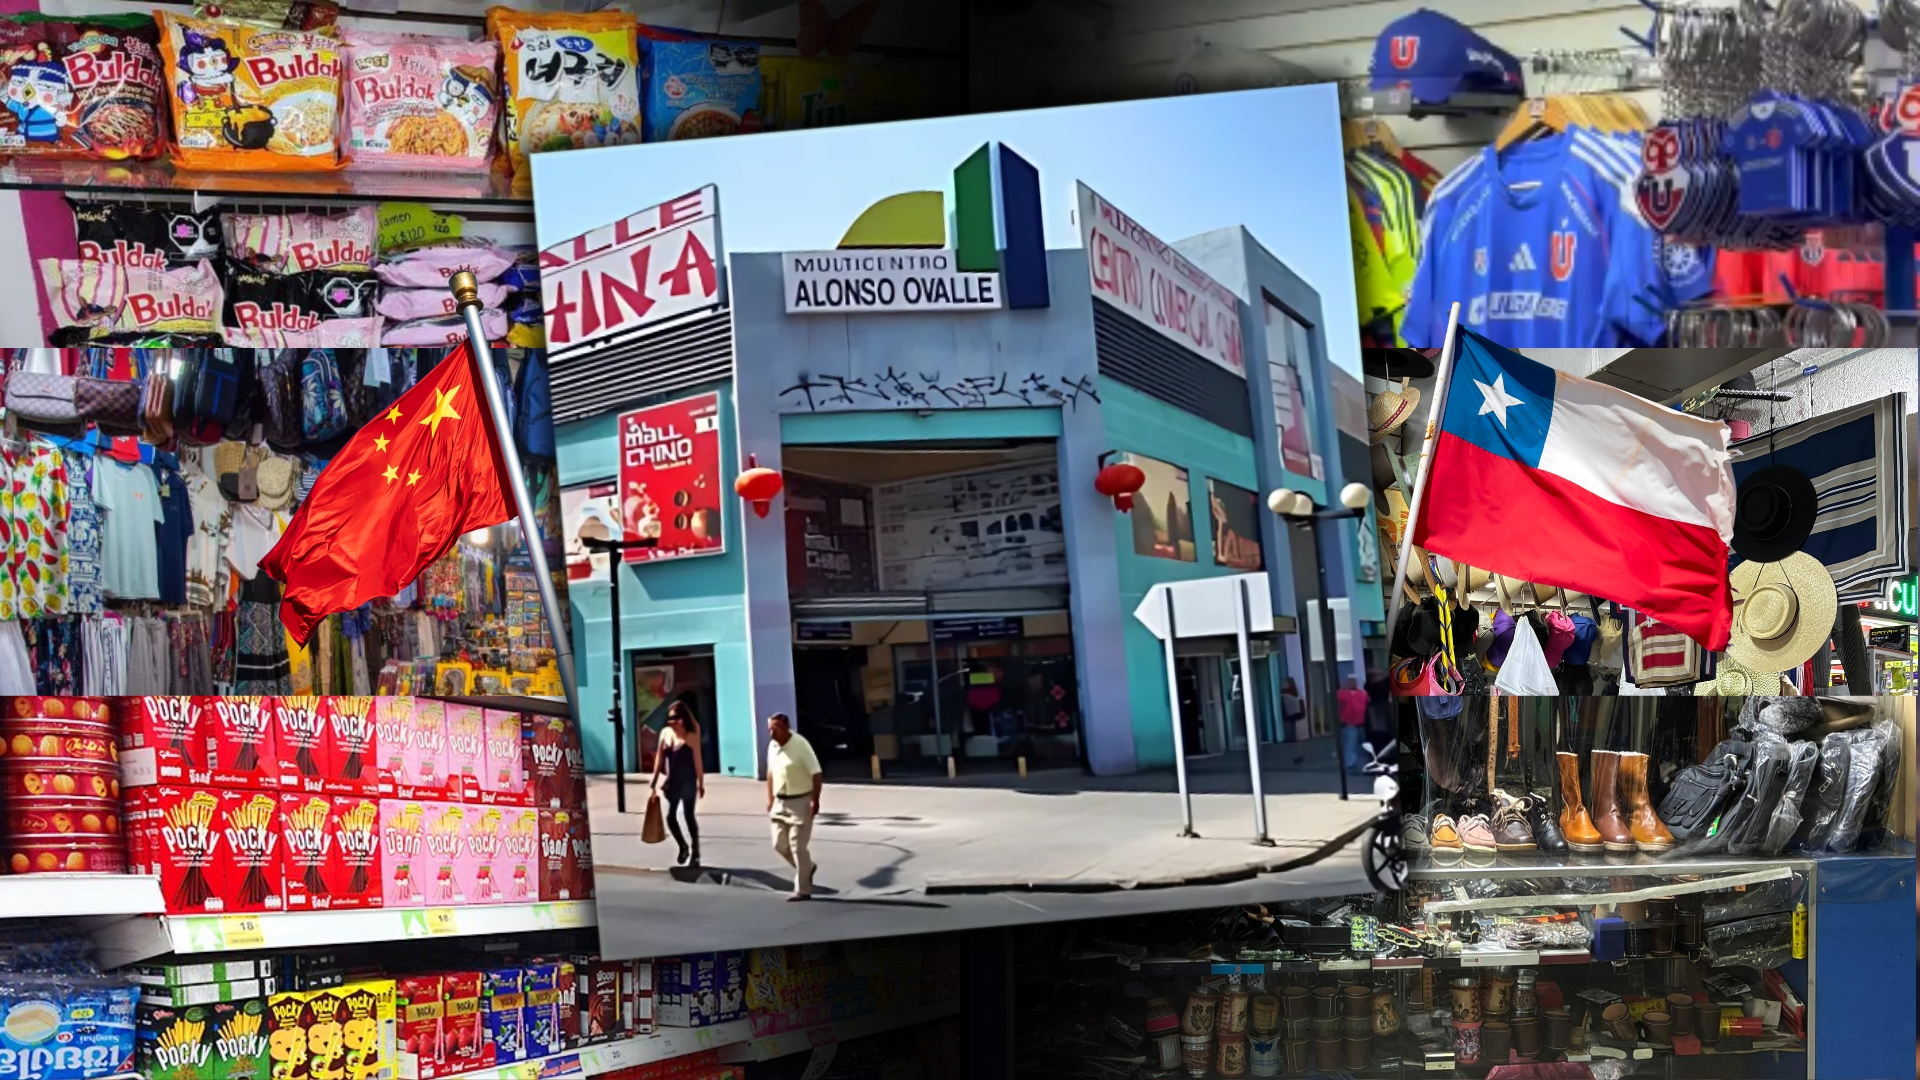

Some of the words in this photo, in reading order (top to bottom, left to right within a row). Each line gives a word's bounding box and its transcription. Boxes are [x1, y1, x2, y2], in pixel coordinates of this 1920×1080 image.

[525, 50, 625, 88] 너구리
[1390, 36, 1420, 70] U
[246, 53, 342, 87] Buldak
[354, 74, 435, 105] Buldak
[794, 256, 948, 272] MULTICENTRO
[795, 277, 895, 307] ALONSO
[903, 275, 994, 304] OVALLE
[625, 438, 693, 467] CHINO
